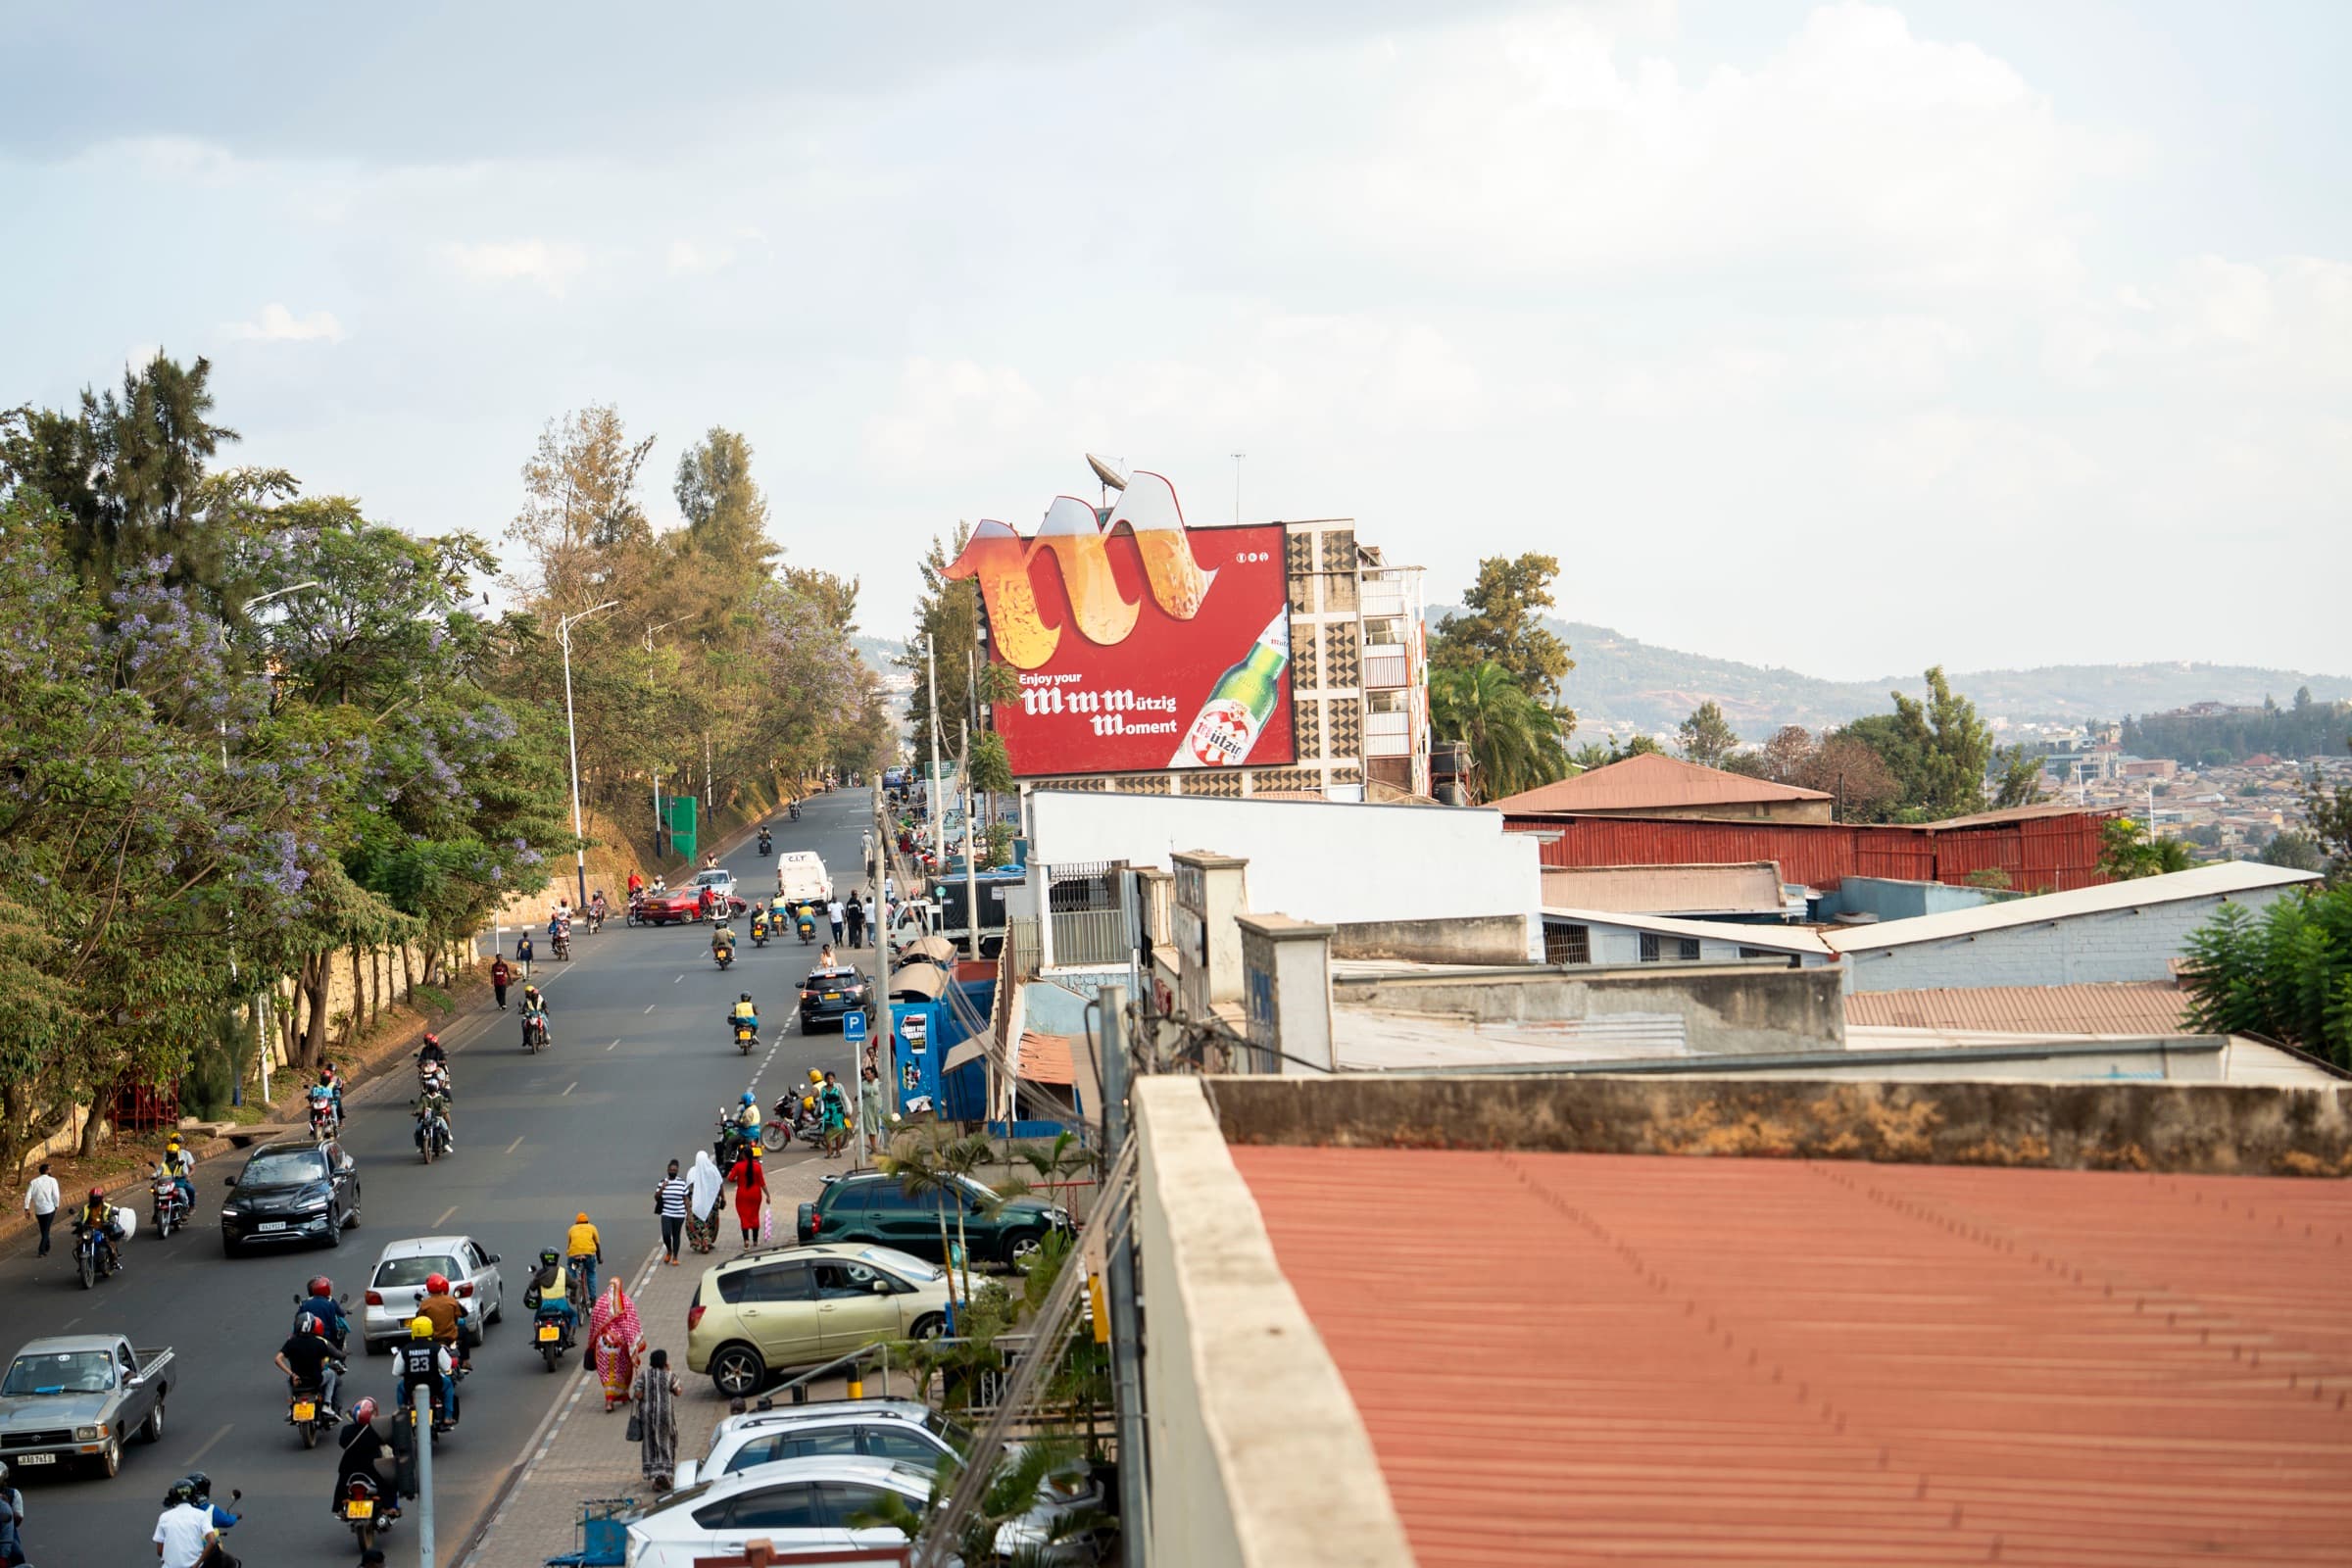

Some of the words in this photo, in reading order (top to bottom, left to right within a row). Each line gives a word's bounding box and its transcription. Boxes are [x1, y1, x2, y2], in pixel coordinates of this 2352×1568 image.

[1018, 673, 1053, 686] Enjoy
[1054, 673, 1083, 685] your
[1089, 712, 1177, 736] Moment
[849, 1016, 859, 1029] P
[410, 1356, 430, 1372] 23
